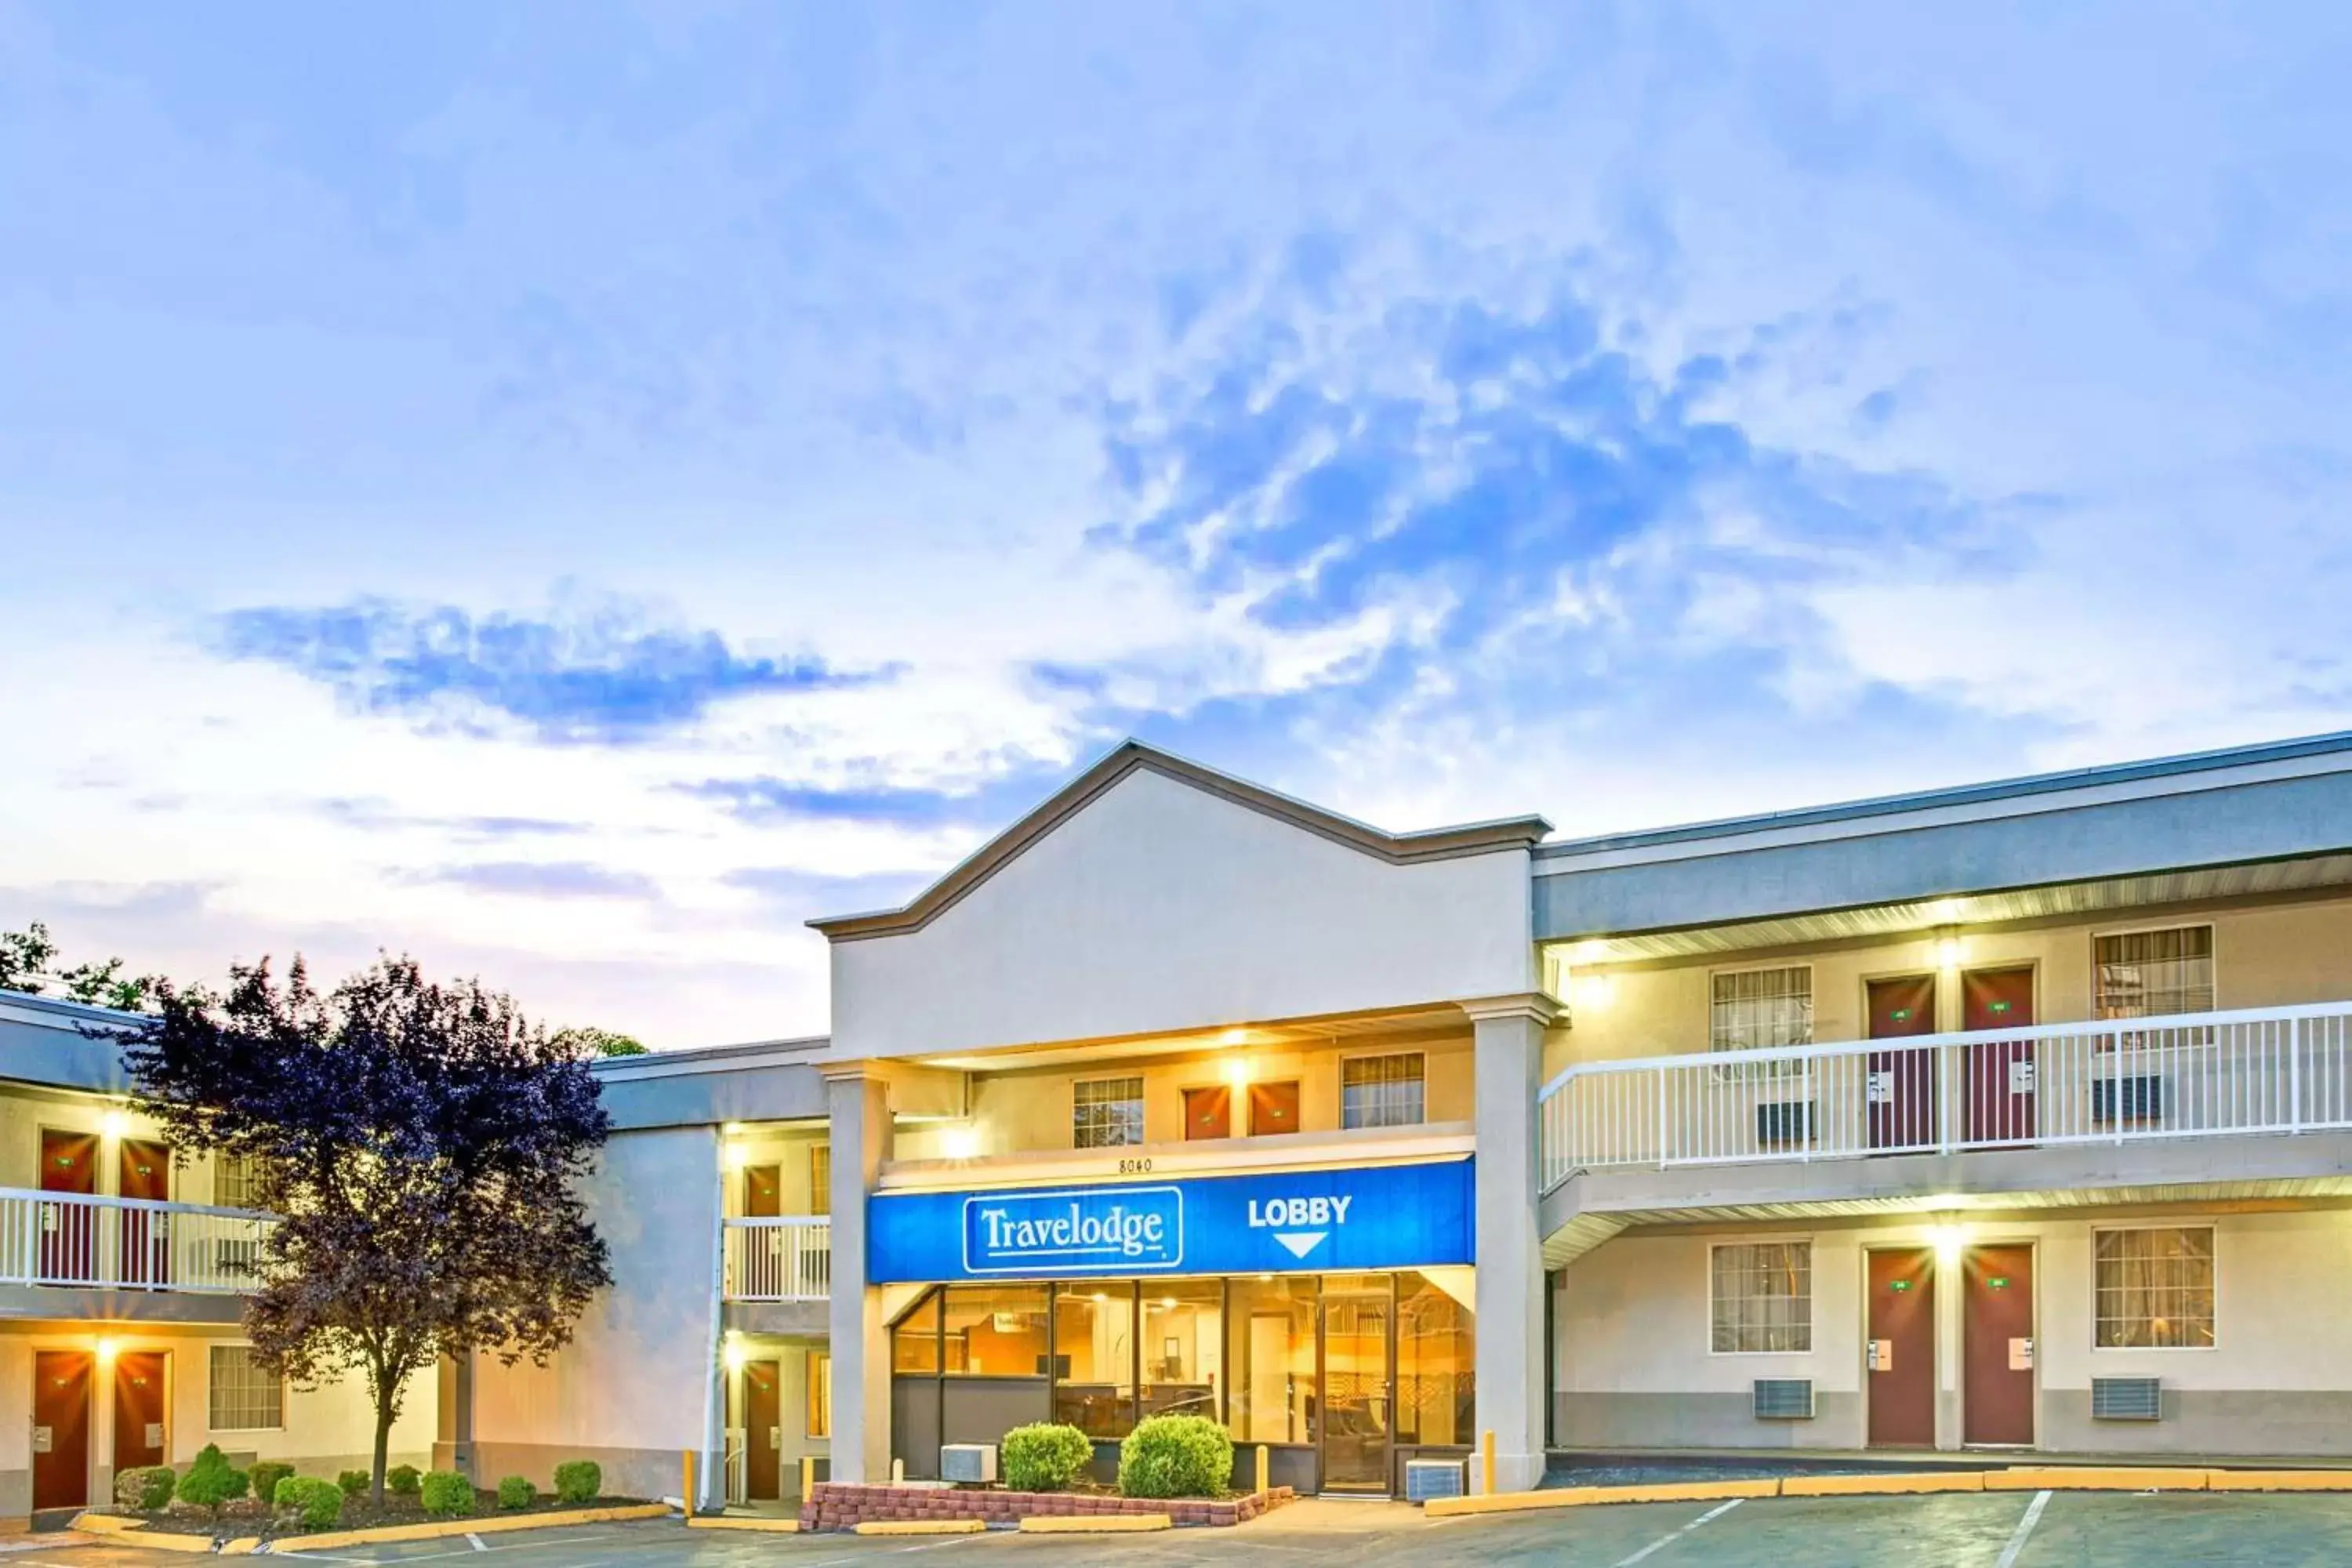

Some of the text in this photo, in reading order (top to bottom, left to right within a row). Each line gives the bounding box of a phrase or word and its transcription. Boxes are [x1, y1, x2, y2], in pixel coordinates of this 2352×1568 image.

[1119, 1158, 1152, 1174] 8040
[1248, 1195, 1352, 1228] LOBBY
[981, 1203, 1163, 1257] Travelodge
